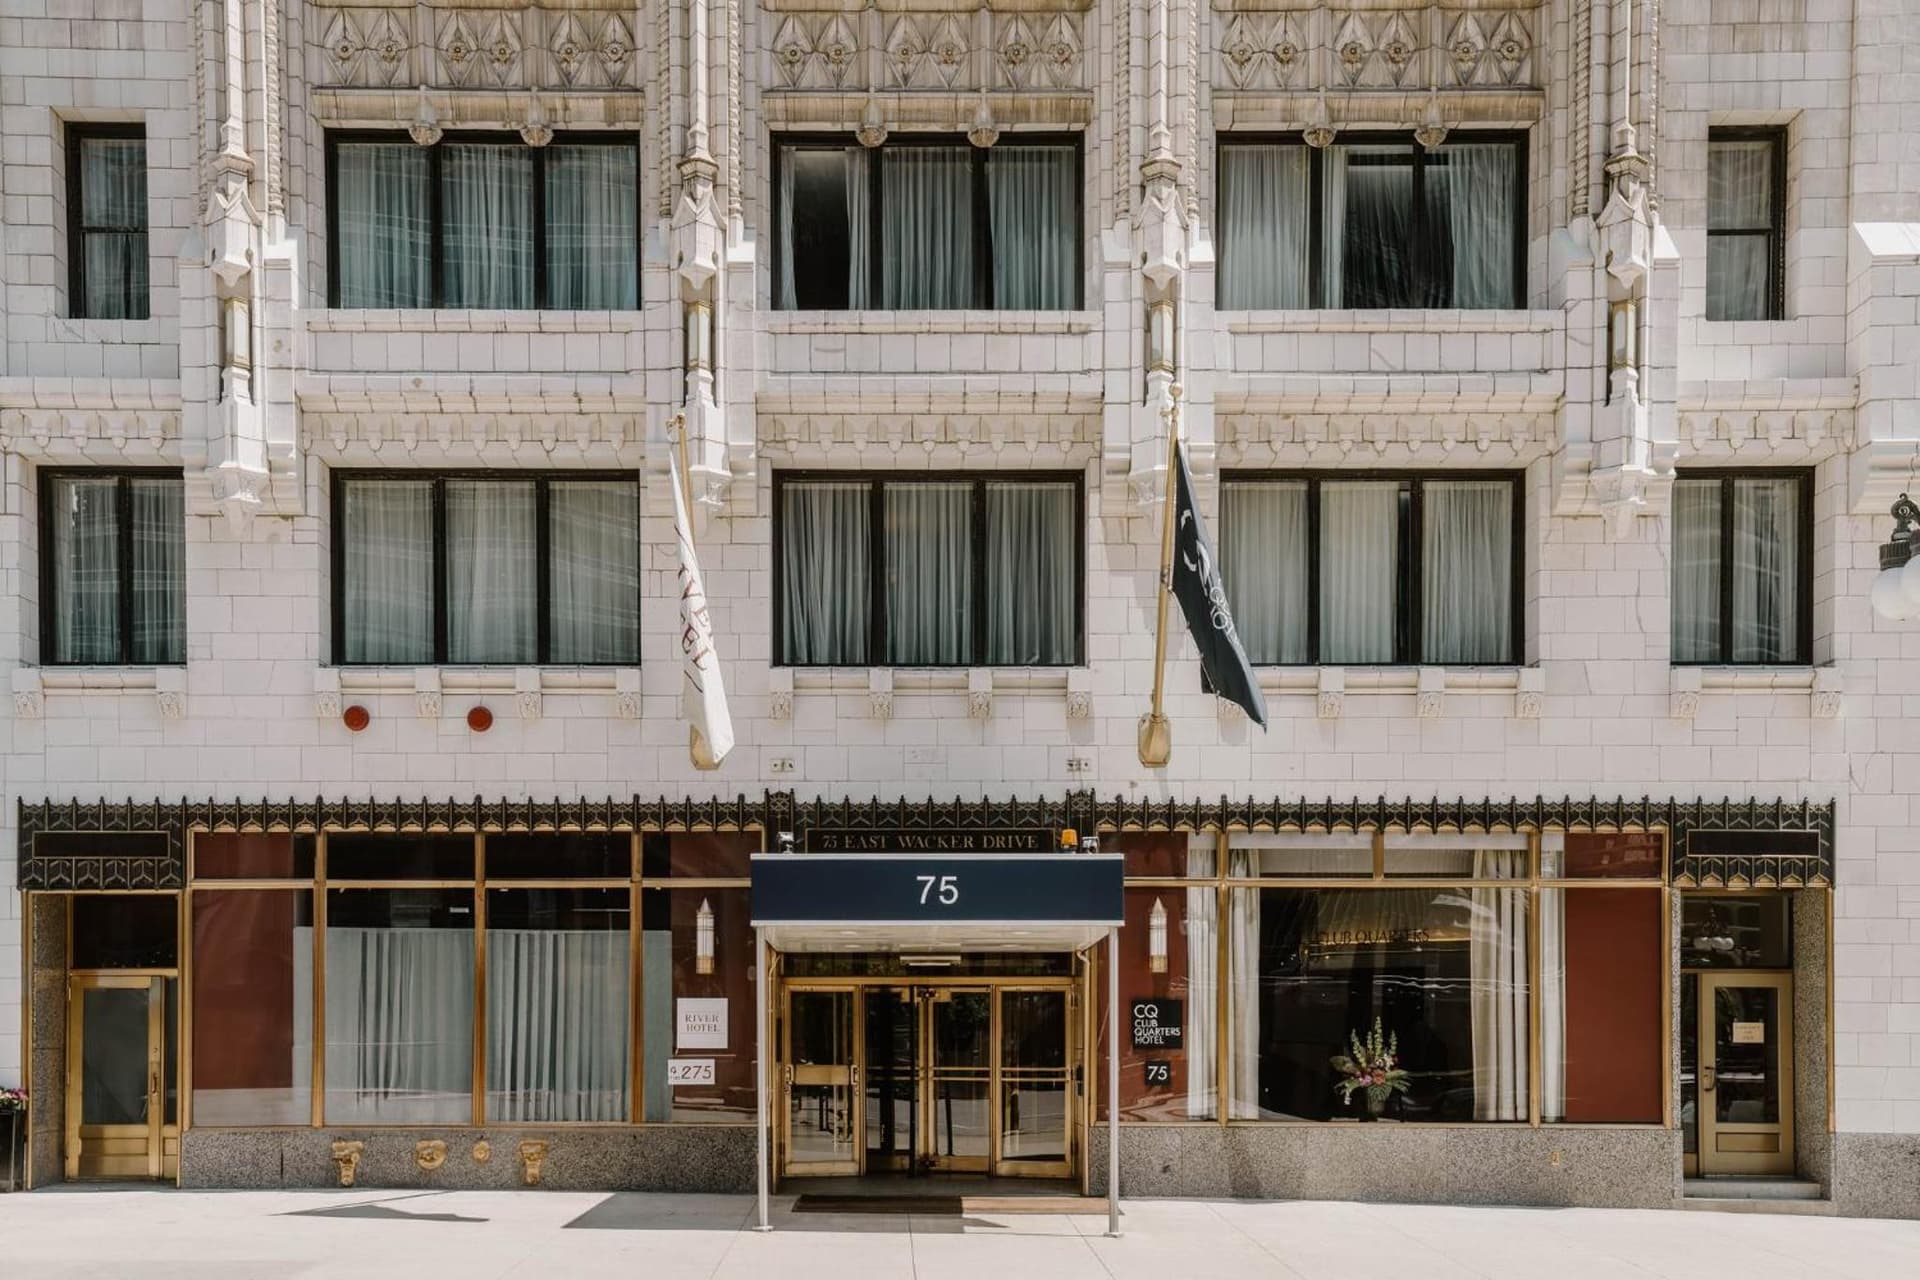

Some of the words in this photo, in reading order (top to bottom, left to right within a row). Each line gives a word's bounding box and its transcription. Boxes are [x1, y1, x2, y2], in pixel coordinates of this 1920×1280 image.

[823, 835, 838, 849] 75
[844, 835, 889, 849] EAST
[896, 835, 974, 849] WACKER
[982, 835, 1039, 849] DRIVE
[916, 876, 959, 905] 75
[1133, 1004, 1159, 1019] CQ
[685, 1014, 720, 1023] RIVER
[1134, 1019, 1158, 1028] CLUB
[686, 1023, 720, 1033] HOTEL
[1133, 1027, 1181, 1037] QUARTERS
[1134, 1036, 1165, 1045] HOTEL
[681, 1065, 712, 1080] 275
[1147, 1065, 1168, 1081] 75
